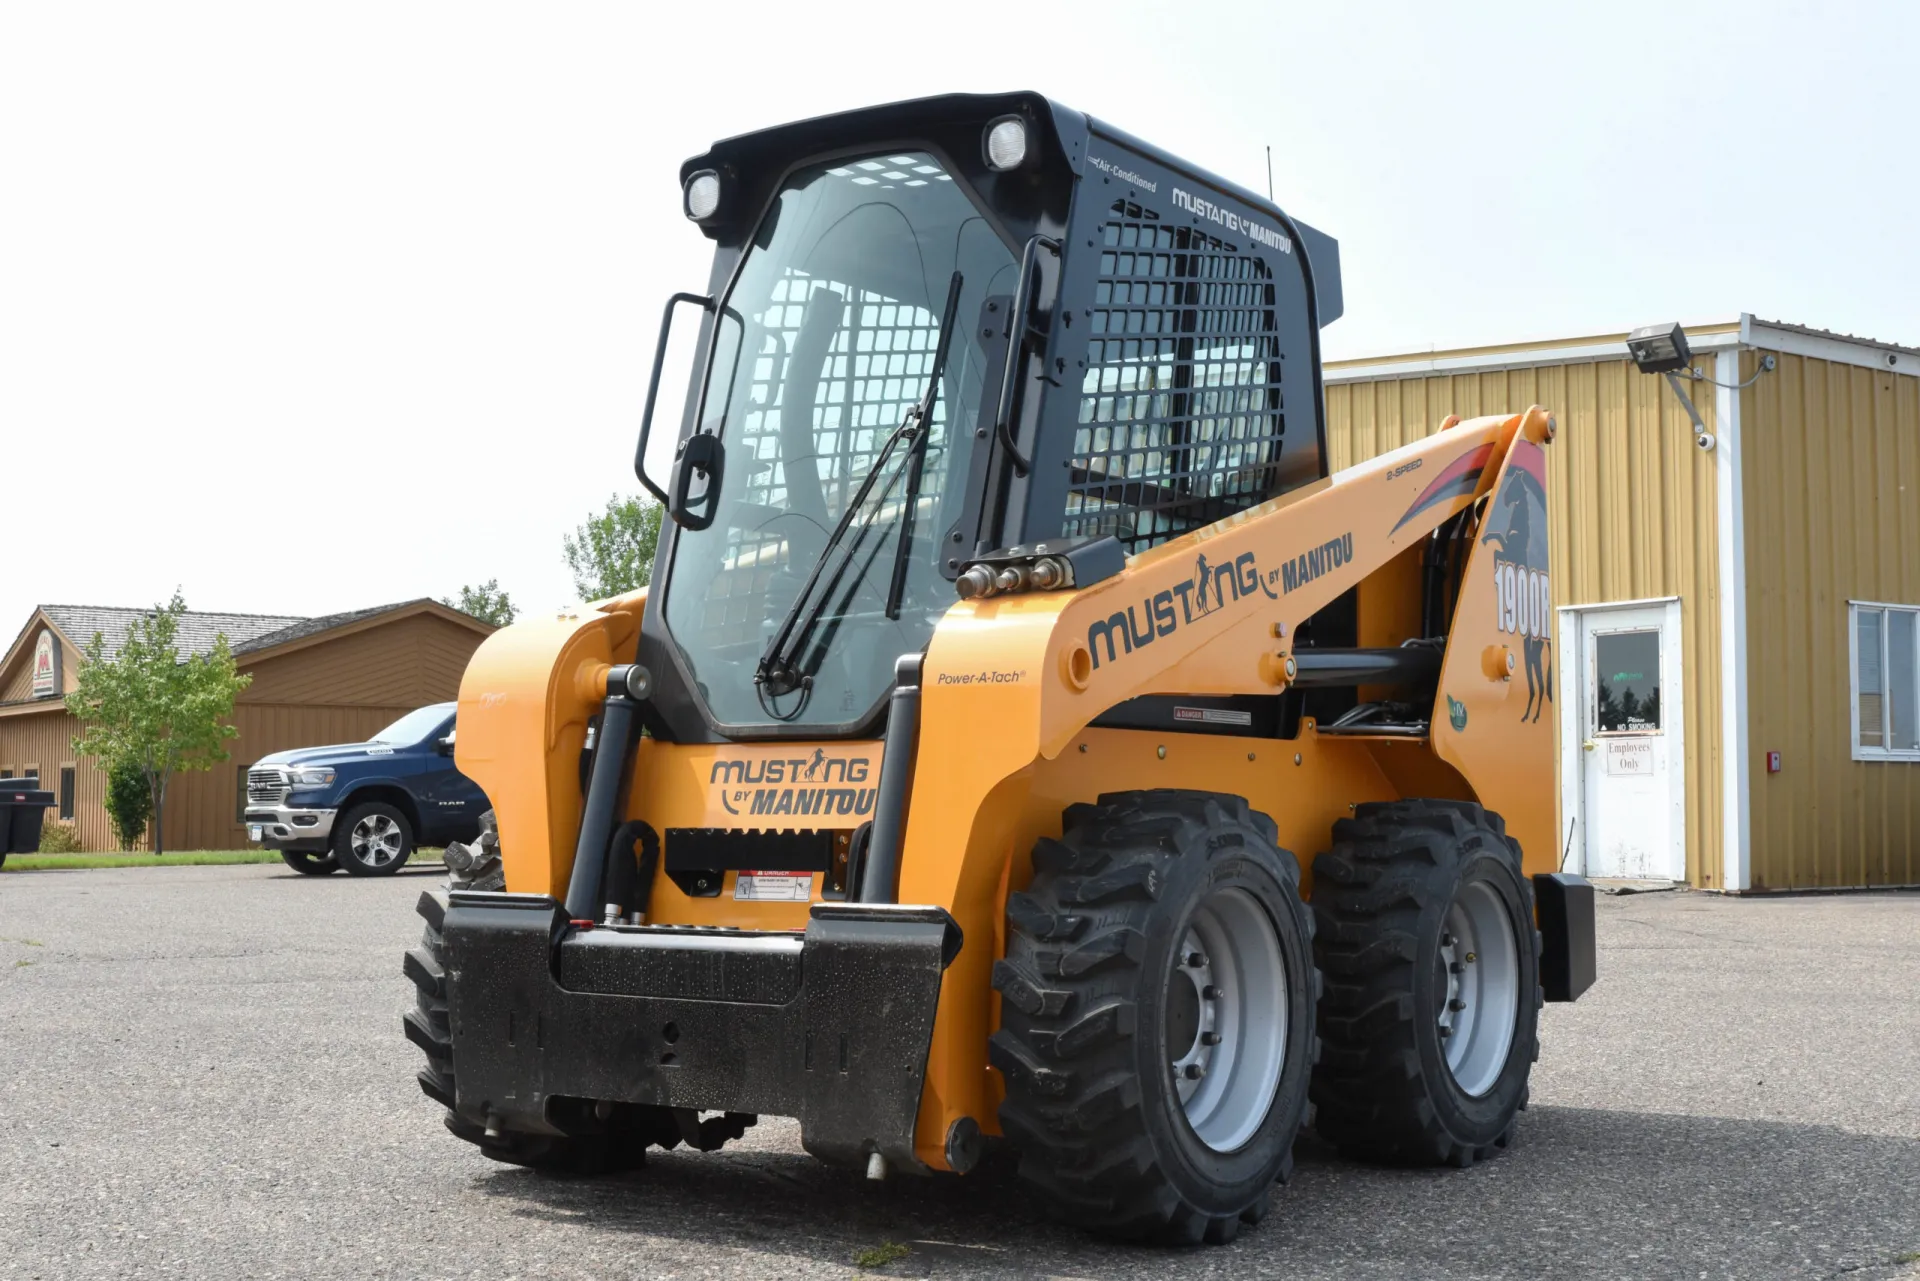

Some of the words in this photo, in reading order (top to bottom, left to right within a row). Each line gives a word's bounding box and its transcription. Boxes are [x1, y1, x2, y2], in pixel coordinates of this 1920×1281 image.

[1098, 158, 1157, 193] Air-Conditioned
[1172, 187, 1238, 233] MUSTANG
[1249, 221, 1292, 255] MANITOU
[1386, 458, 1423, 481] 2-SPEED
[1087, 551, 1260, 671] MUSTANG
[1268, 567, 1280, 584] BY
[1281, 531, 1354, 596] MANITOU
[1629, 723, 1655, 731] SMOKING
[1608, 742, 1650, 755] Employees
[710, 748, 869, 784] MUSTANG
[1620, 758, 1639, 771] Only
[733, 789, 751, 802] BY
[750, 788, 877, 816] MANITOU
